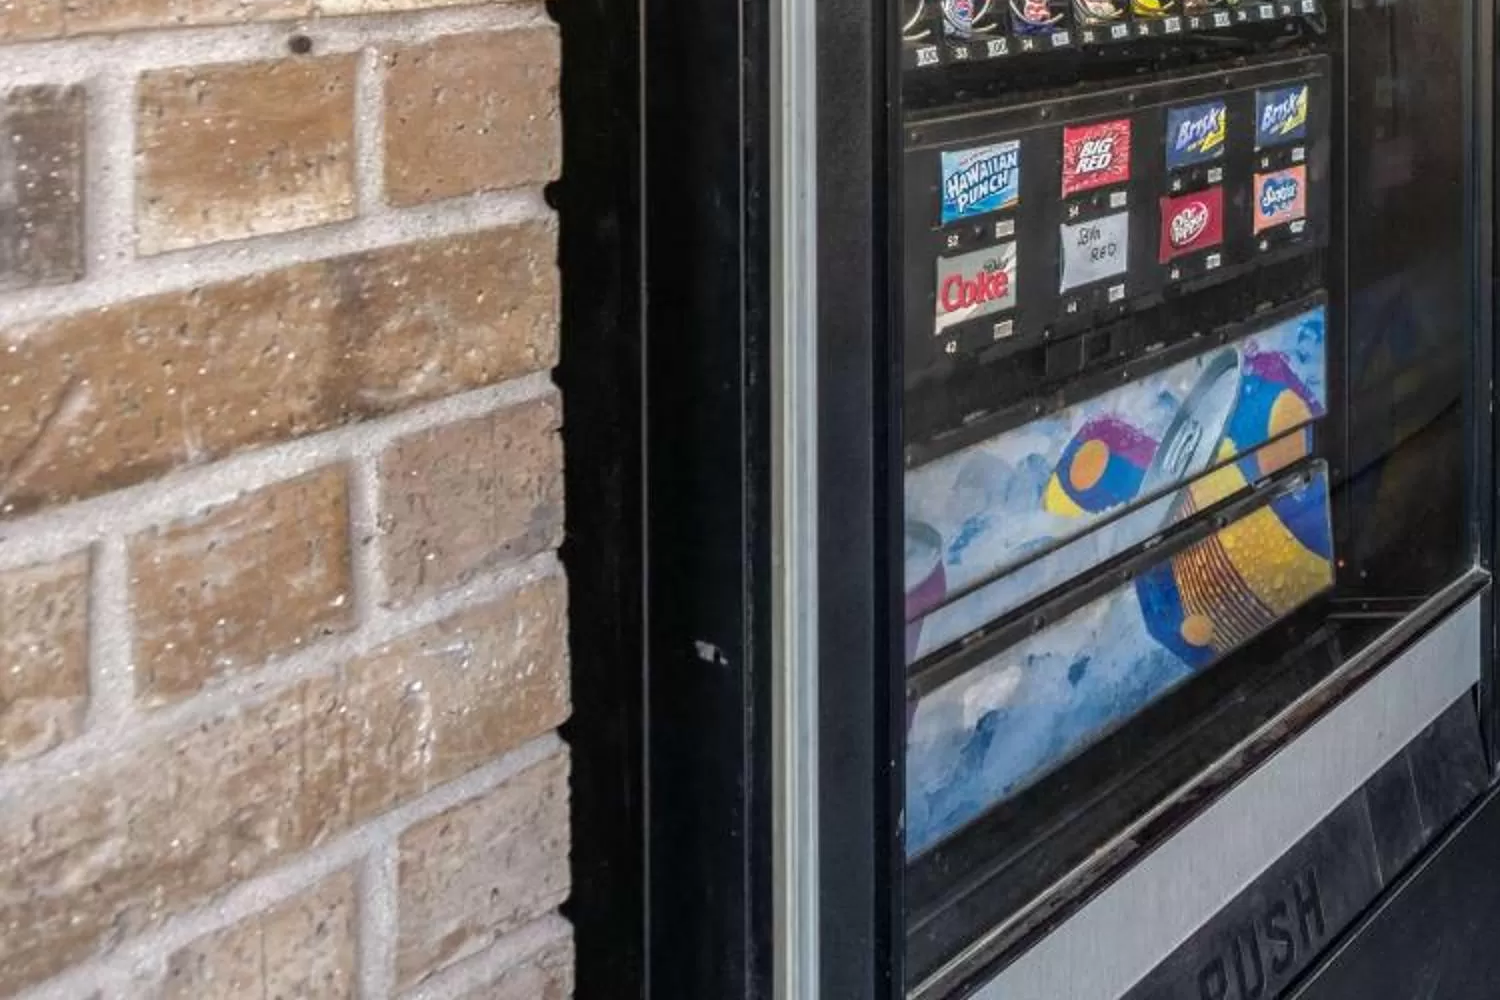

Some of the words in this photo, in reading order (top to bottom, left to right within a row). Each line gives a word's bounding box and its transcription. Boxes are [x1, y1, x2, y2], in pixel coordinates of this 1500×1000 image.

[1076, 153, 1112, 175] RED
[1080, 137, 1113, 158] BIG
[946, 150, 1018, 199] HAWAIIAN
[957, 169, 1008, 213] PUNCH
[941, 271, 1009, 313] Coke
[1198, 865, 1326, 1000] PUSH
